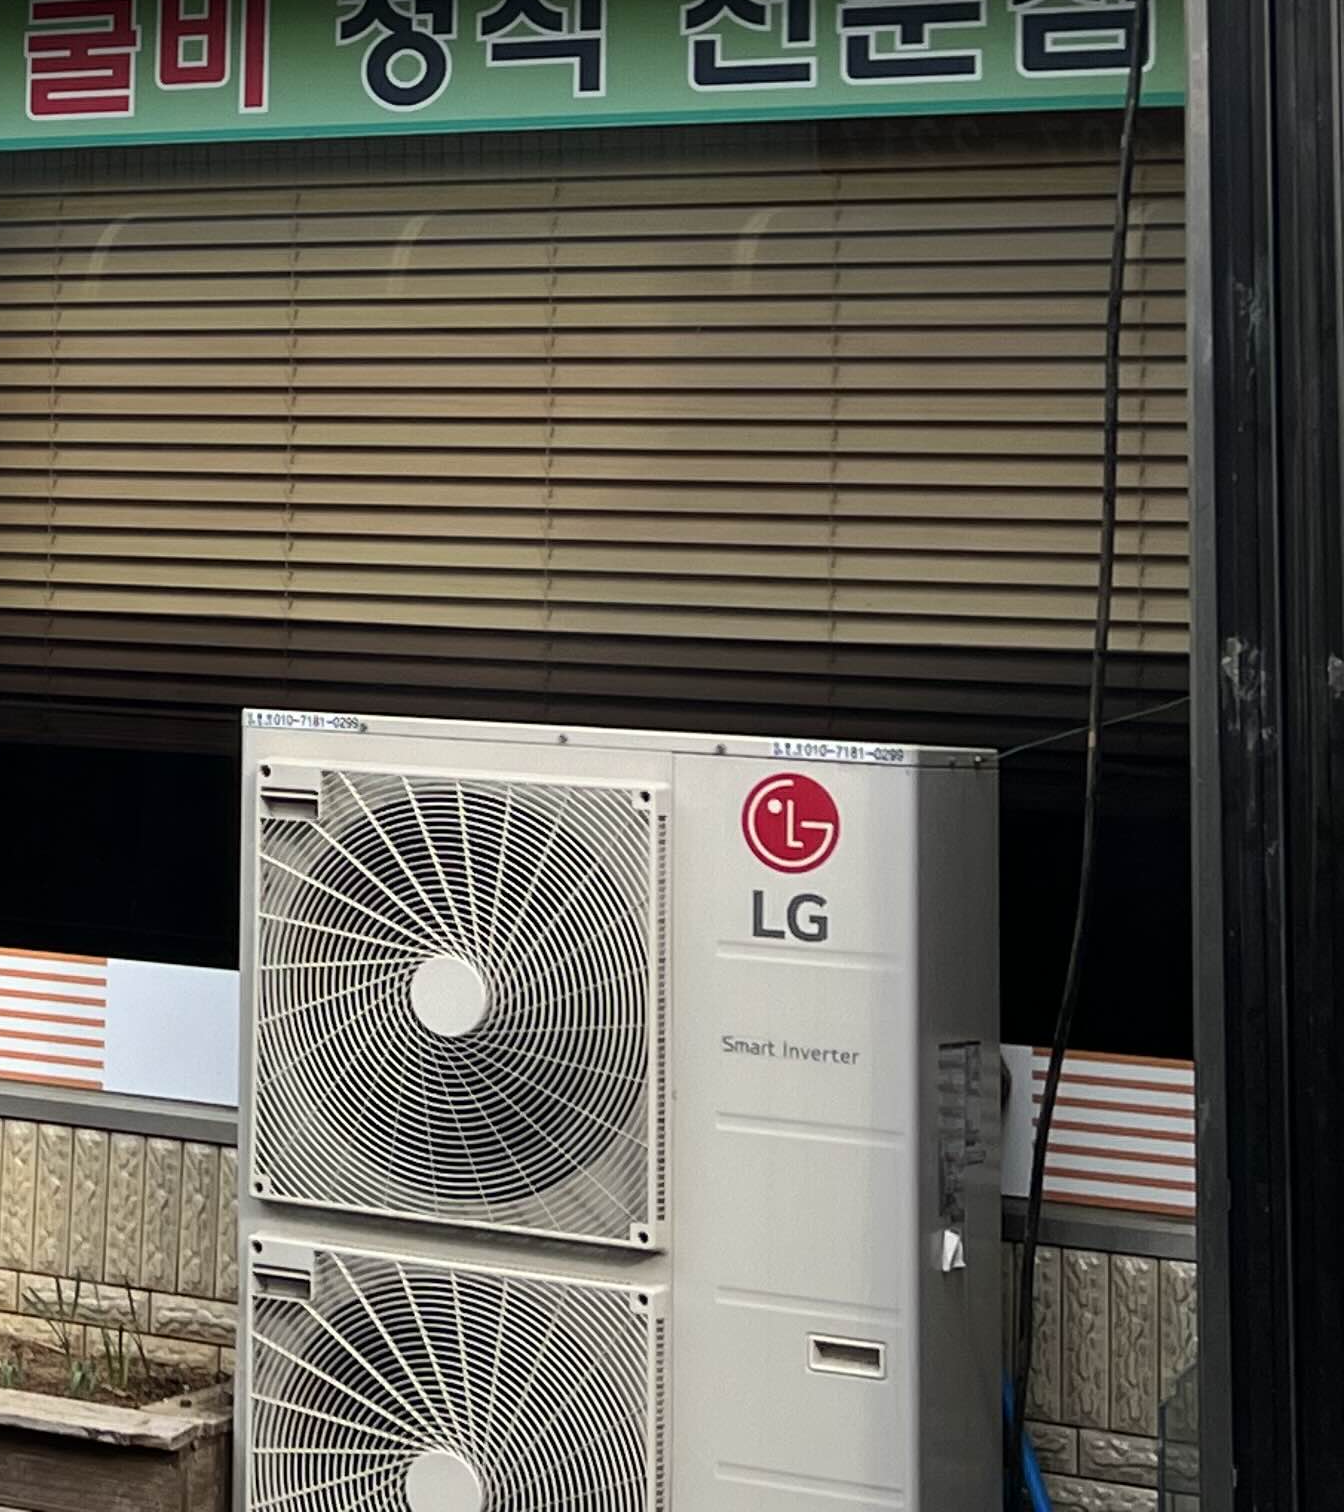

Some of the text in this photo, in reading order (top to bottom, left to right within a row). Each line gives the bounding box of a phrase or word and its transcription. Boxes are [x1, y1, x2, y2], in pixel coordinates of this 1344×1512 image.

[752, 890, 829, 942] LG
[722, 1035, 861, 1066] Smart Inverter
